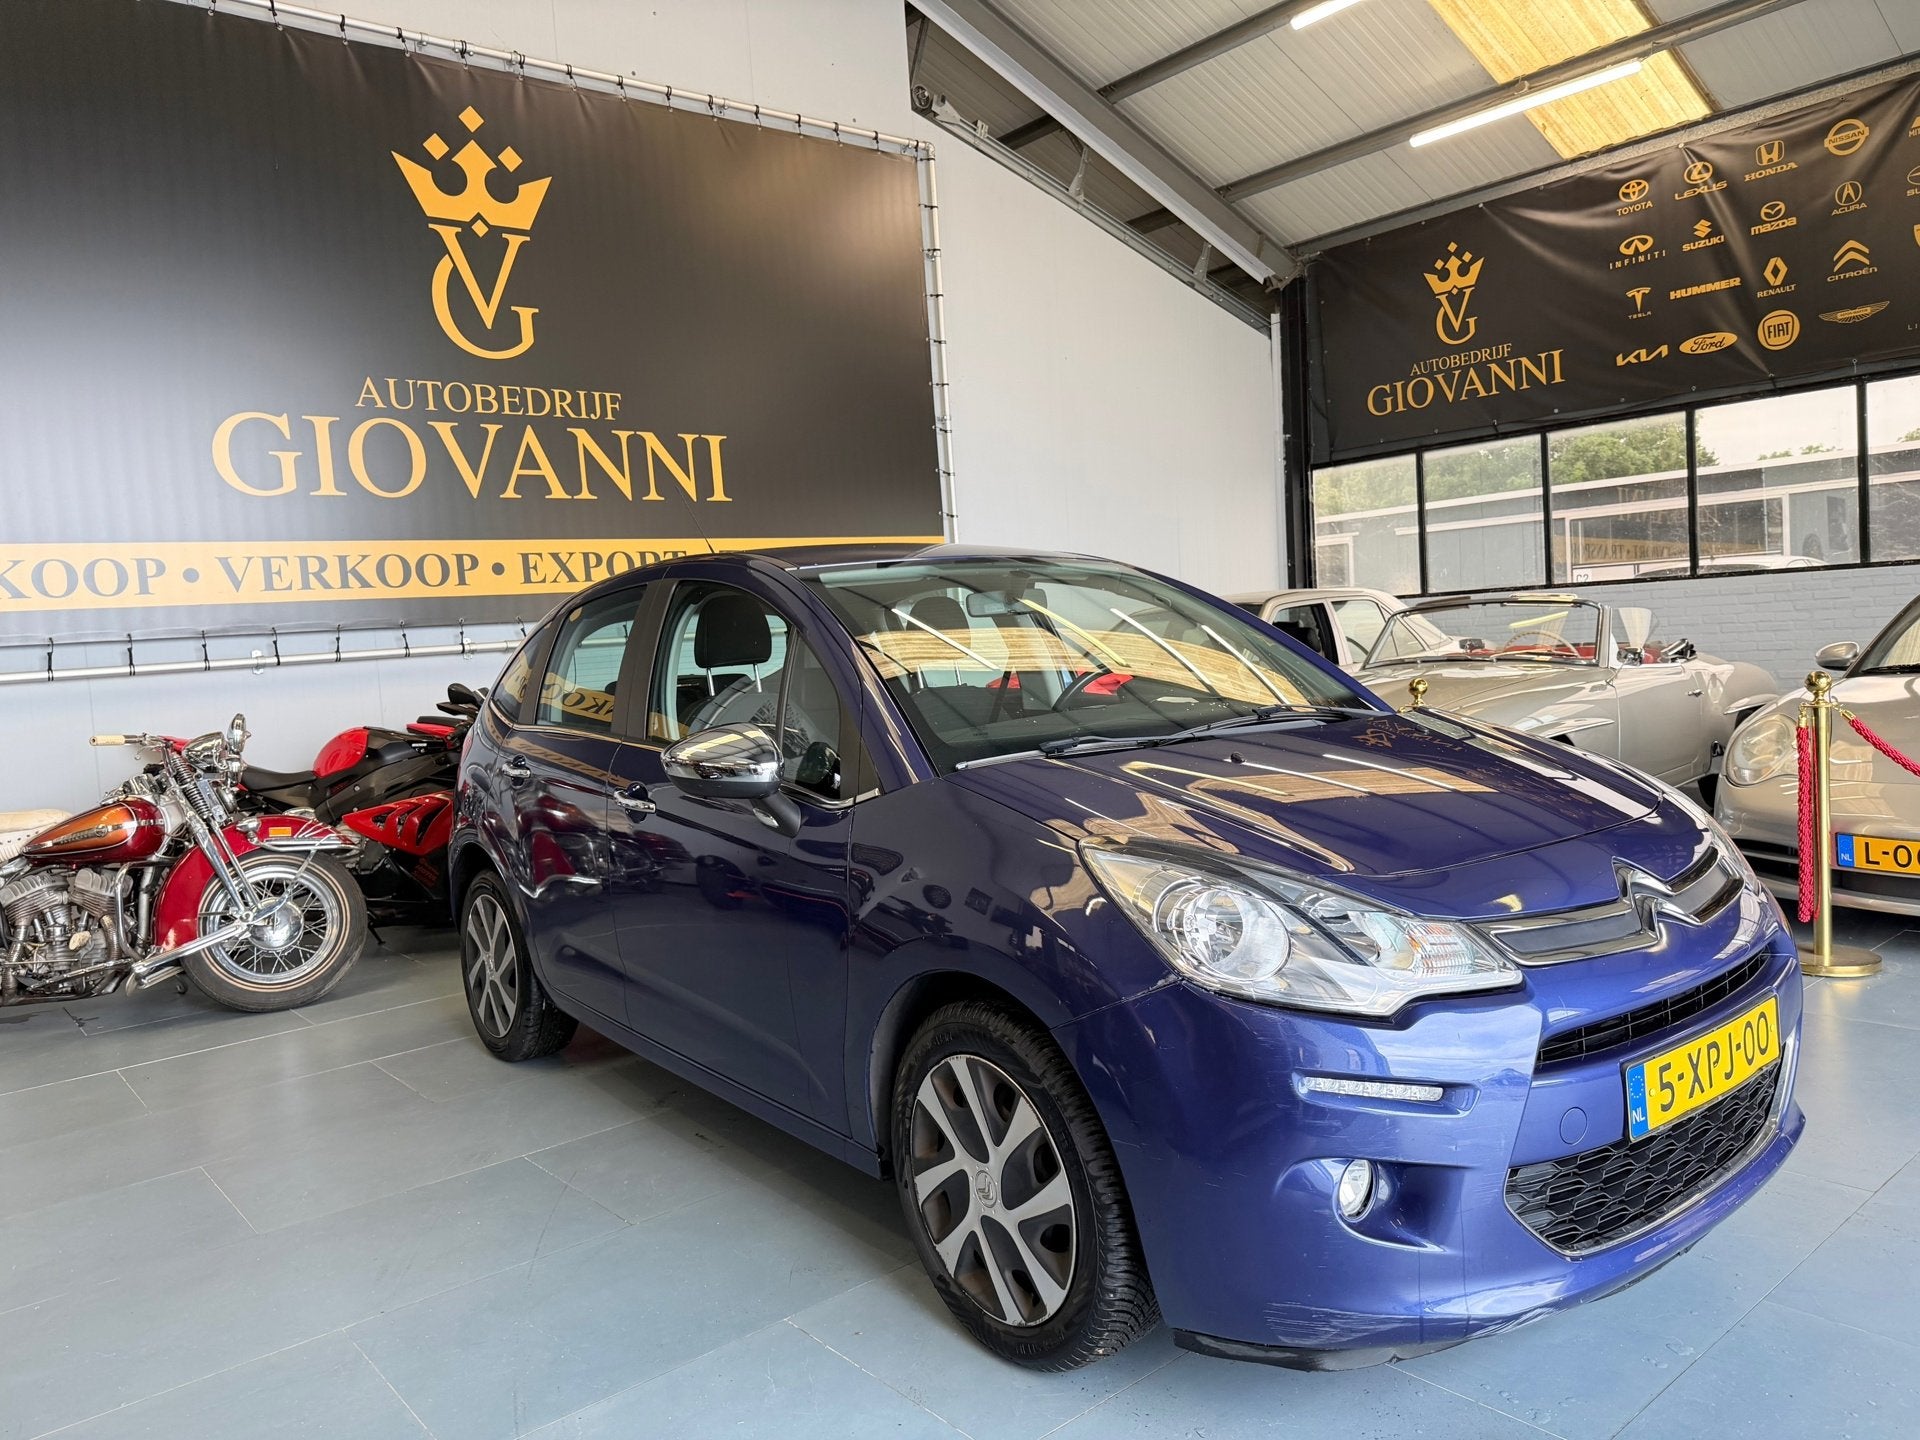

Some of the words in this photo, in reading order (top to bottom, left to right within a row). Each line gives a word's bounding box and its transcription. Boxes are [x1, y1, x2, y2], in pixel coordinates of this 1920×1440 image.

[1828, 129, 1866, 147] NISSAN
[1744, 161, 1798, 182] HONDA
[1675, 180, 1728, 200] LEXUS
[1616, 201, 1653, 216] TOYOTA
[1831, 202, 1867, 216] ACURA
[1682, 234, 1725, 252] SUZUKI
[1609, 250, 1666, 270] INFINITI
[1669, 277, 1742, 300] HUMMER
[1757, 284, 1796, 299] RENAULT
[1628, 310, 1652, 319] TESLA
[1766, 321, 1791, 339] FIAT
[1690, 335, 1726, 353] Ford
[1410, 343, 1512, 376] AUTOBEDRIJF
[1367, 349, 1566, 416] GIOVANNI
[355, 376, 622, 421] AUTOBEDRIJF
[211, 411, 733, 503] GIOVANNI
[225, 552, 480, 593] VERKOOP
[1840, 853, 1853, 861] NL
[1632, 1110, 1646, 1127] NL
